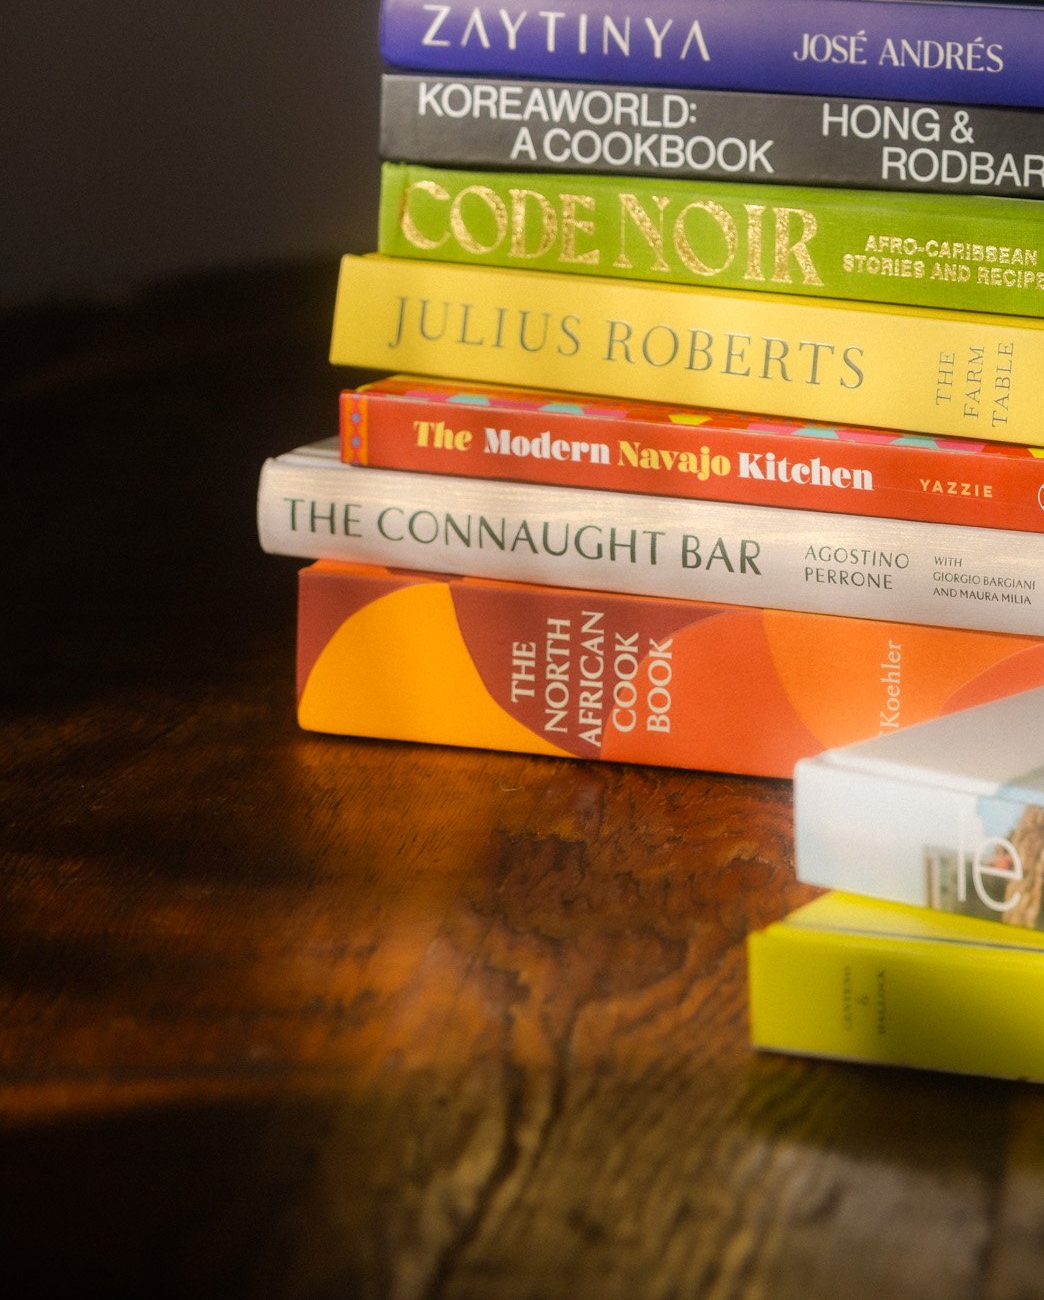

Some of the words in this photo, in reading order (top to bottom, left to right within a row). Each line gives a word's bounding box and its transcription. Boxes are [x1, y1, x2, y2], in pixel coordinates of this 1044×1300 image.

[421, 4, 711, 62] ZAYTINYA
[793, 30, 868, 65] JOSÉ
[879, 36, 1004, 73] ANDRÉS
[418, 82, 698, 129] KOREAWORLD:
[821, 103, 940, 142] HONG
[950, 108, 975, 144] &
[510, 128, 538, 161] A
[543, 128, 775, 174] COOKBOOK
[400, 180, 601, 266] CODE
[613, 193, 826, 287] NOIR
[864, 234, 1038, 267] AFRO-CARIBBEAN
[842, 253, 926, 281] STORIES
[929, 261, 972, 285] AND
[388, 296, 582, 358] JULIUS
[602, 318, 866, 390] ROBERTS
[935, 350, 956, 407] THE
[964, 345, 986, 419] FARM
[991, 341, 1014, 428] TABLE
[413, 420, 473, 453] The
[482, 427, 612, 466] Modern
[617, 441, 732, 483] Navajo
[736, 451, 874, 492] Kitchen
[919, 478, 994, 499] YAZZIE
[284, 497, 364, 538] THE
[376, 506, 667, 566] CONNAUGHT
[680, 534, 763, 577] BAR
[804, 544, 911, 570] AGOSTINO
[934, 555, 963, 568] WITH
[804, 567, 894, 590] PERRONE
[932, 571, 981, 585] GIORGIO
[983, 576, 1036, 590] BARGIANI
[932, 587, 958, 598] AND
[959, 589, 999, 602] MAURA
[1001, 593, 1032, 605] MILIA
[511, 640, 537, 704] THE
[544, 617, 572, 733] NORTH
[577, 609, 605, 749] AFRICAN
[611, 631, 640, 734] COOK
[646, 637, 674, 734] BOOK
[880, 639, 902, 728] Koehler
